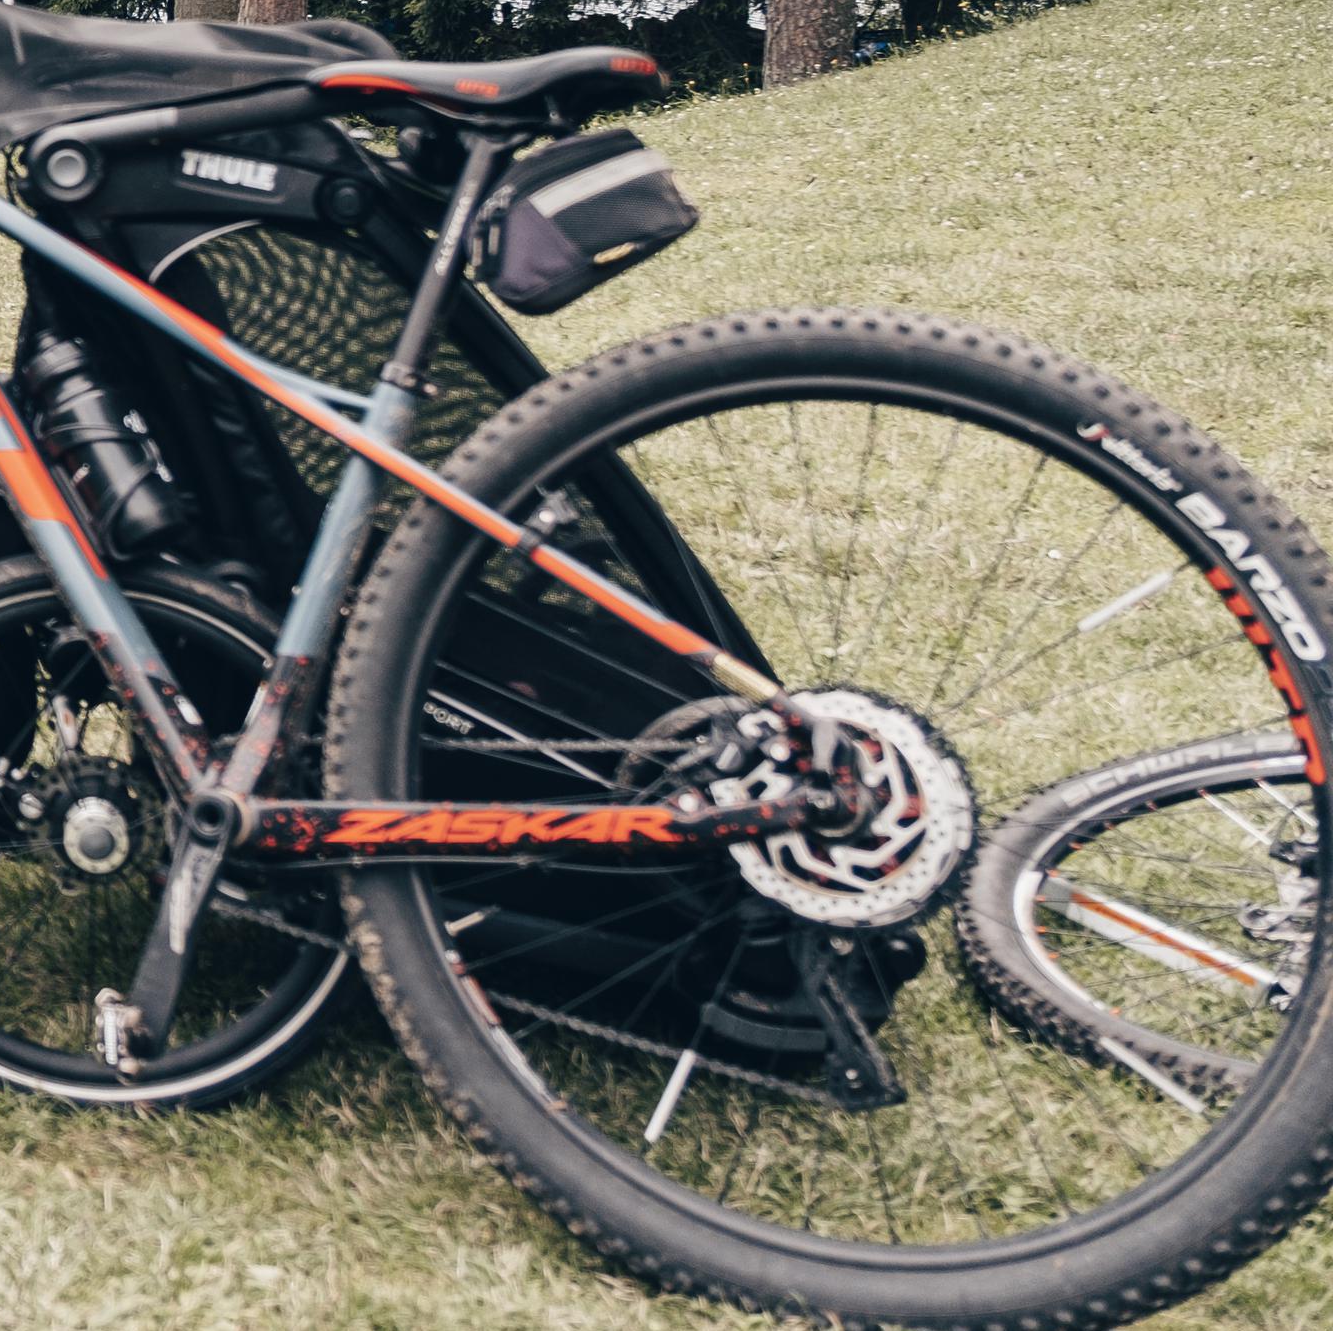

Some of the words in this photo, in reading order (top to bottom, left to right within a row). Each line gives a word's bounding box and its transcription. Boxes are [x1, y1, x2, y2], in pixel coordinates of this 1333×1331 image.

[181, 150, 277, 191] THULE
[1175, 491, 1326, 662] BARZO
[1061, 734, 1303, 808] SCHWALB
[323, 808, 681, 844] ZASKAR
